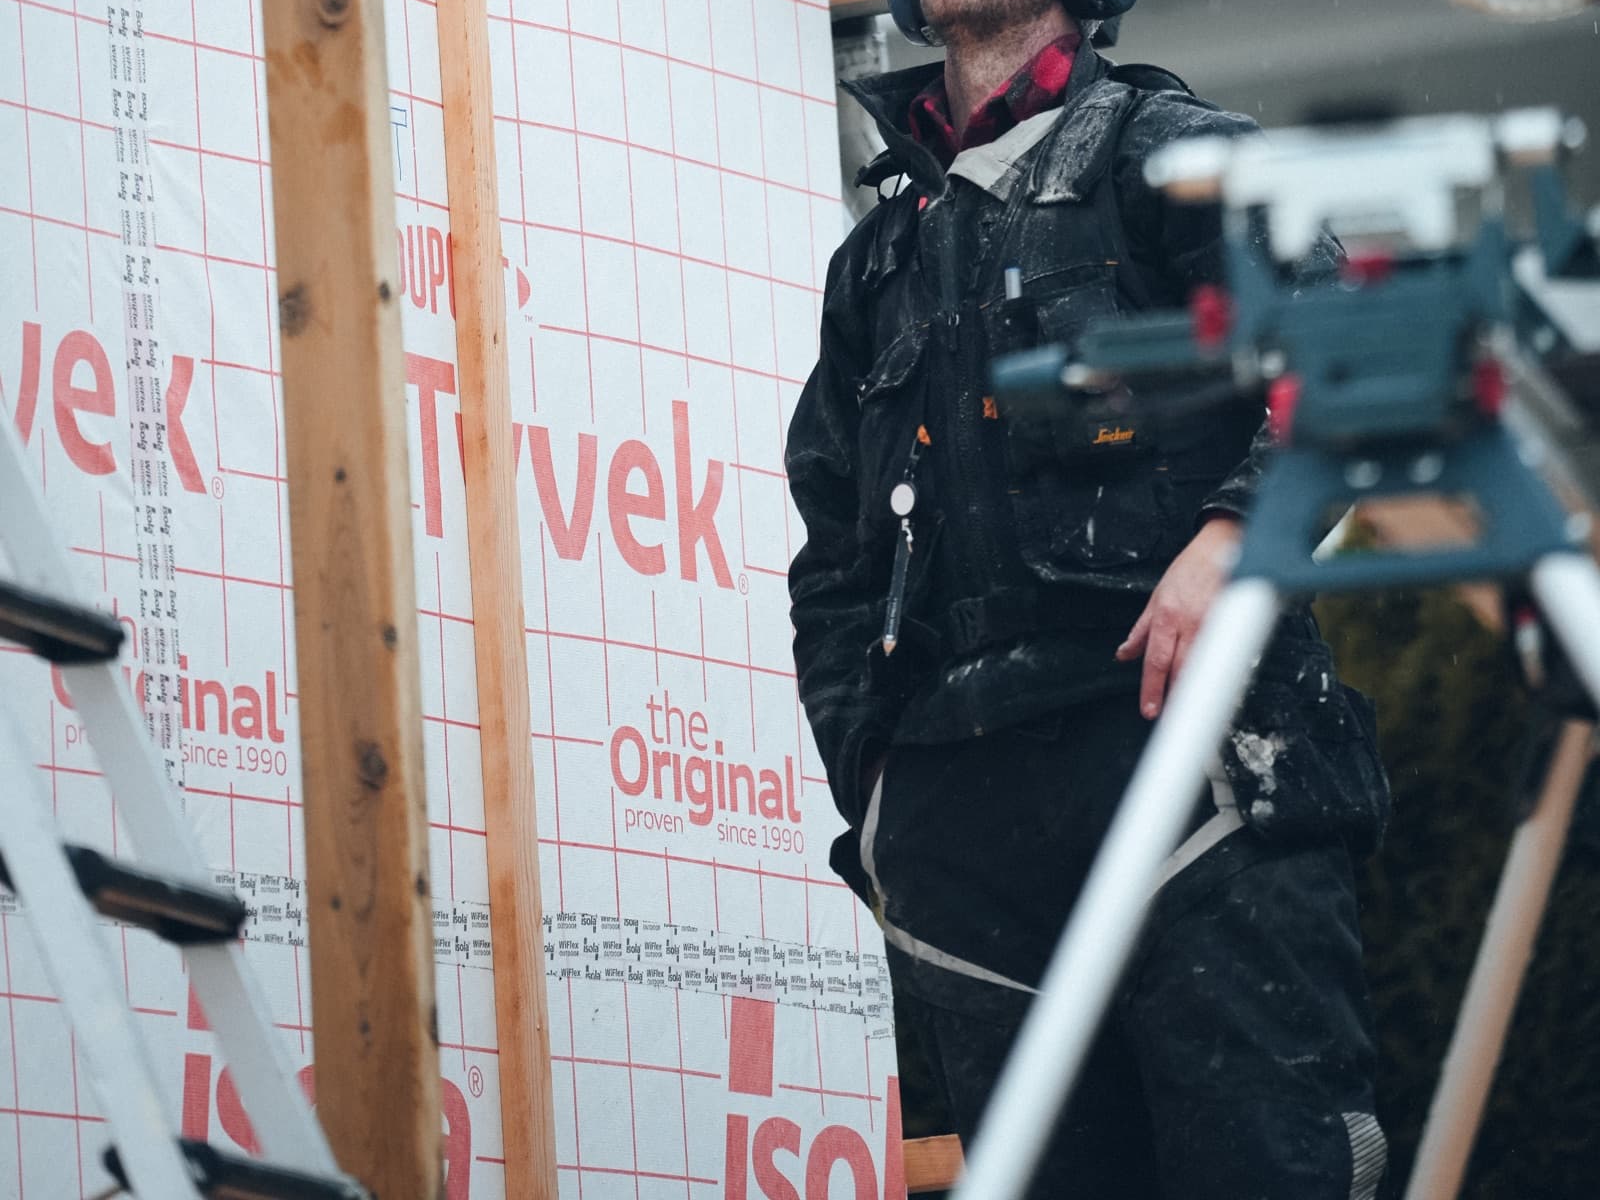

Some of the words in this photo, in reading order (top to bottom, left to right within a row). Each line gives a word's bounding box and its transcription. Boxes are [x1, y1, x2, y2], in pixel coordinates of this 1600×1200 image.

[646, 689, 709, 751] the
[235, 745, 287, 776] 1990
[610, 725, 801, 827] Original
[625, 808, 684, 833] proven
[717, 817, 757, 848] since
[761, 824, 805, 855] 1990
[556, 912, 577, 922] WiFlex
[455, 936, 470, 960] isola
[559, 940, 579, 950] WiFlex
[584, 937, 600, 961] isola
[603, 941, 622, 950] WiFlex
[626, 938, 642, 961] isola
[561, 968, 581, 978] WiFlex
[605, 968, 625, 978] WiFlex
[646, 969, 665, 978] WiFlex
[667, 966, 683, 989] isola
